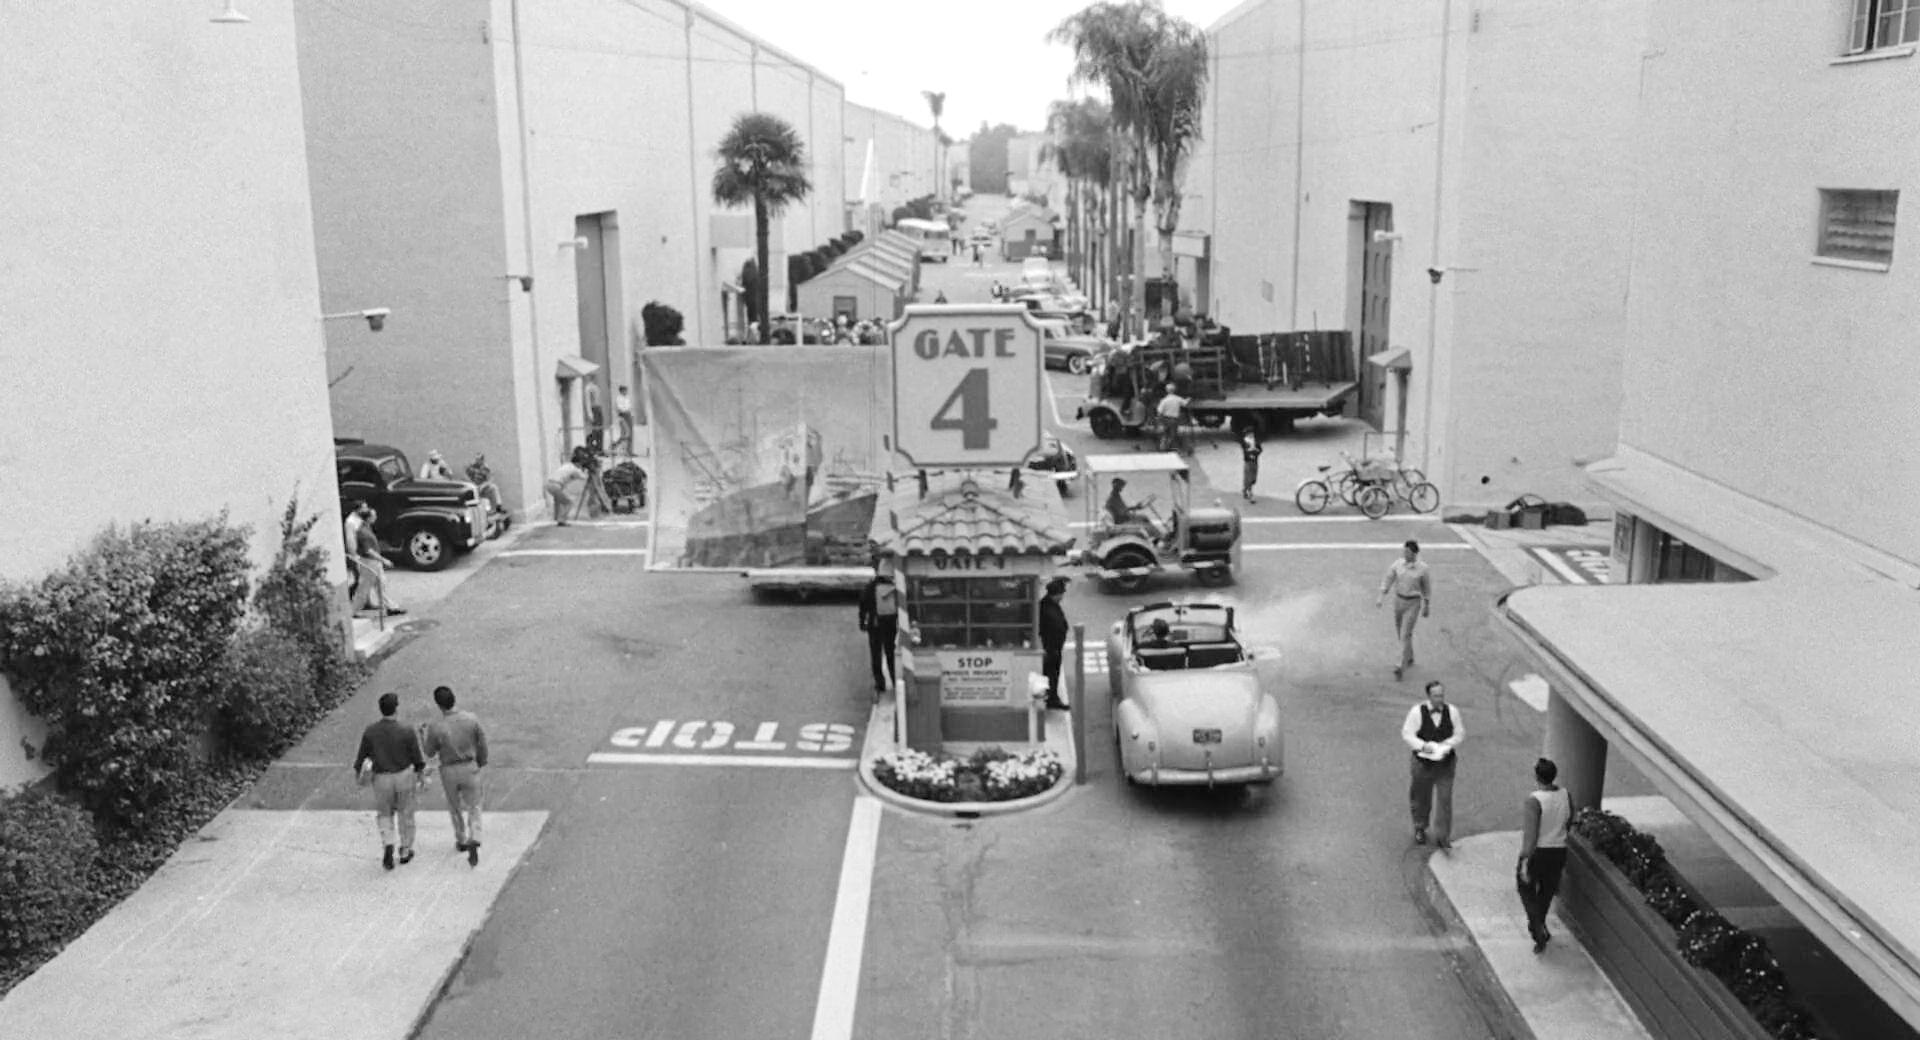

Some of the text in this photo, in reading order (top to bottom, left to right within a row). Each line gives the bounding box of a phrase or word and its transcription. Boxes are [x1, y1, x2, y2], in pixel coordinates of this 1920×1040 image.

[914, 329, 1016, 360] GATE
[930, 368, 998, 450] 4
[957, 657, 993, 668] STOP
[610, 719, 856, 752] STOP
